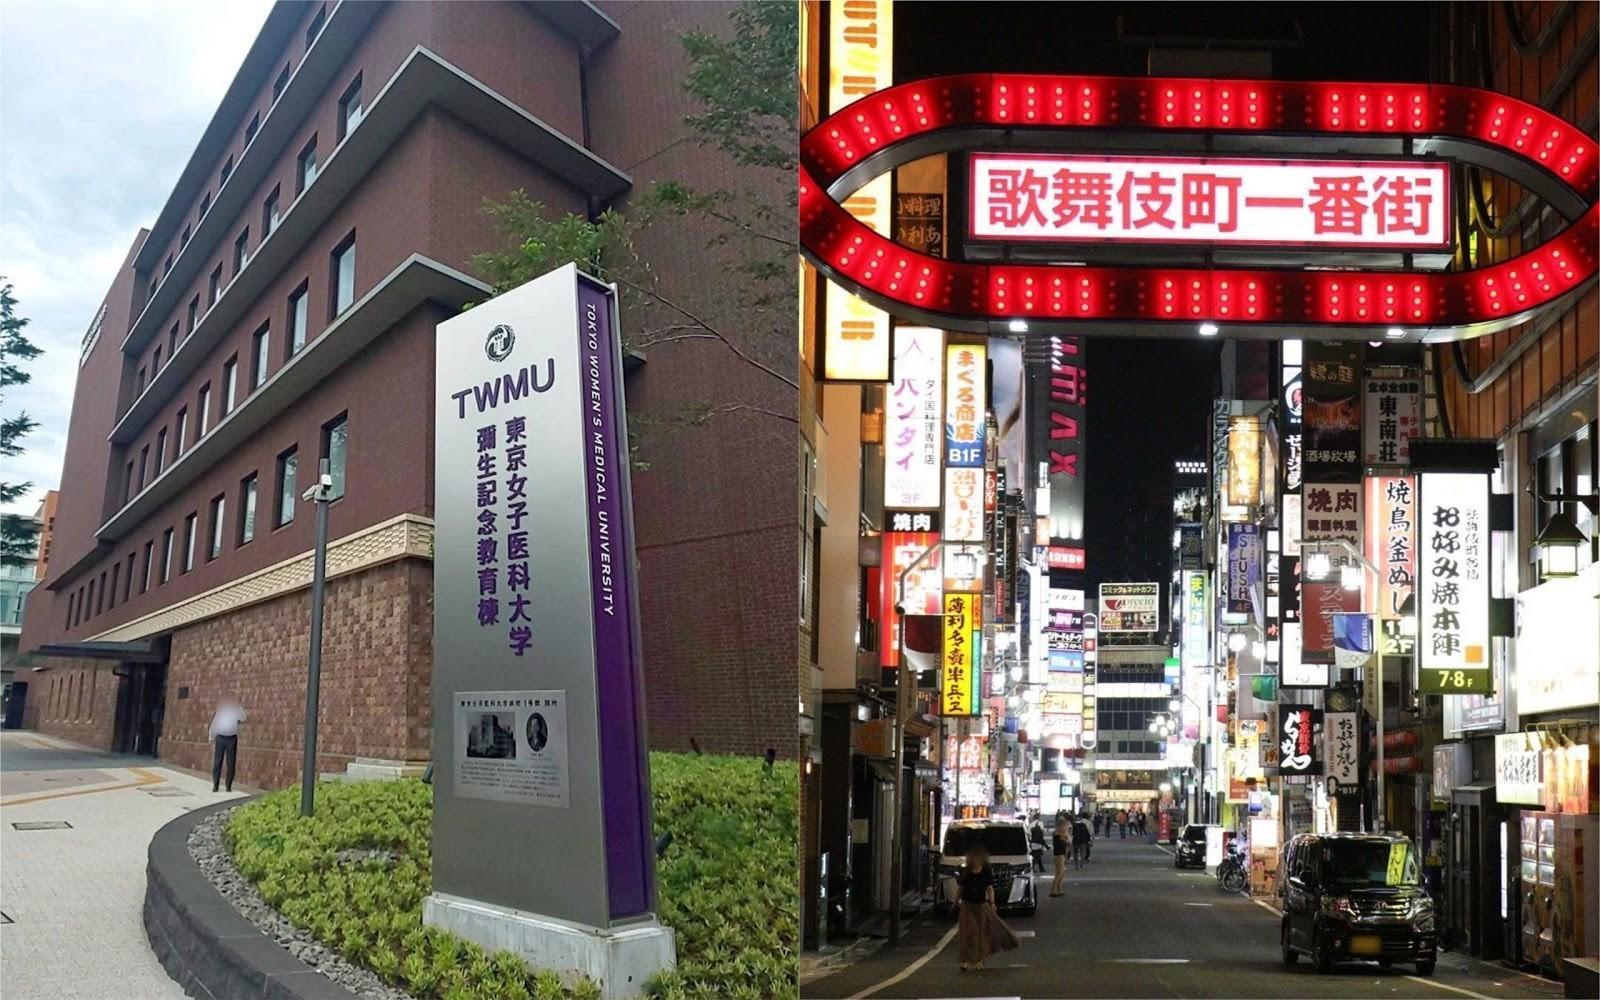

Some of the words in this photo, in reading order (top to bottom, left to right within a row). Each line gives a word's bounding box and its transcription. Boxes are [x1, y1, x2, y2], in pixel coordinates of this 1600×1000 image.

[988, 168, 1432, 235] 歌舞伎町一番街
[585, 303, 598, 350] TOKYO
[451, 358, 555, 419] TWMU
[590, 355, 602, 426] WOMEN'S
[950, 449, 980, 462] B1F
[1379, 395, 1397, 462] 東南荘
[594, 432, 604, 503] MEDICAL
[901, 493, 920, 503] 3F
[1308, 488, 1357, 512] 焼肉
[476, 428, 500, 626] 彌生記念教育棟
[505, 417, 532, 656] 東京女子医科大学
[893, 514, 931, 530] 焼肉
[1387, 479, 1411, 616] 焼鳥釜めし
[599, 511, 613, 616] UNIVERSITY
[1432, 505, 1460, 656] お好み焼本陣
